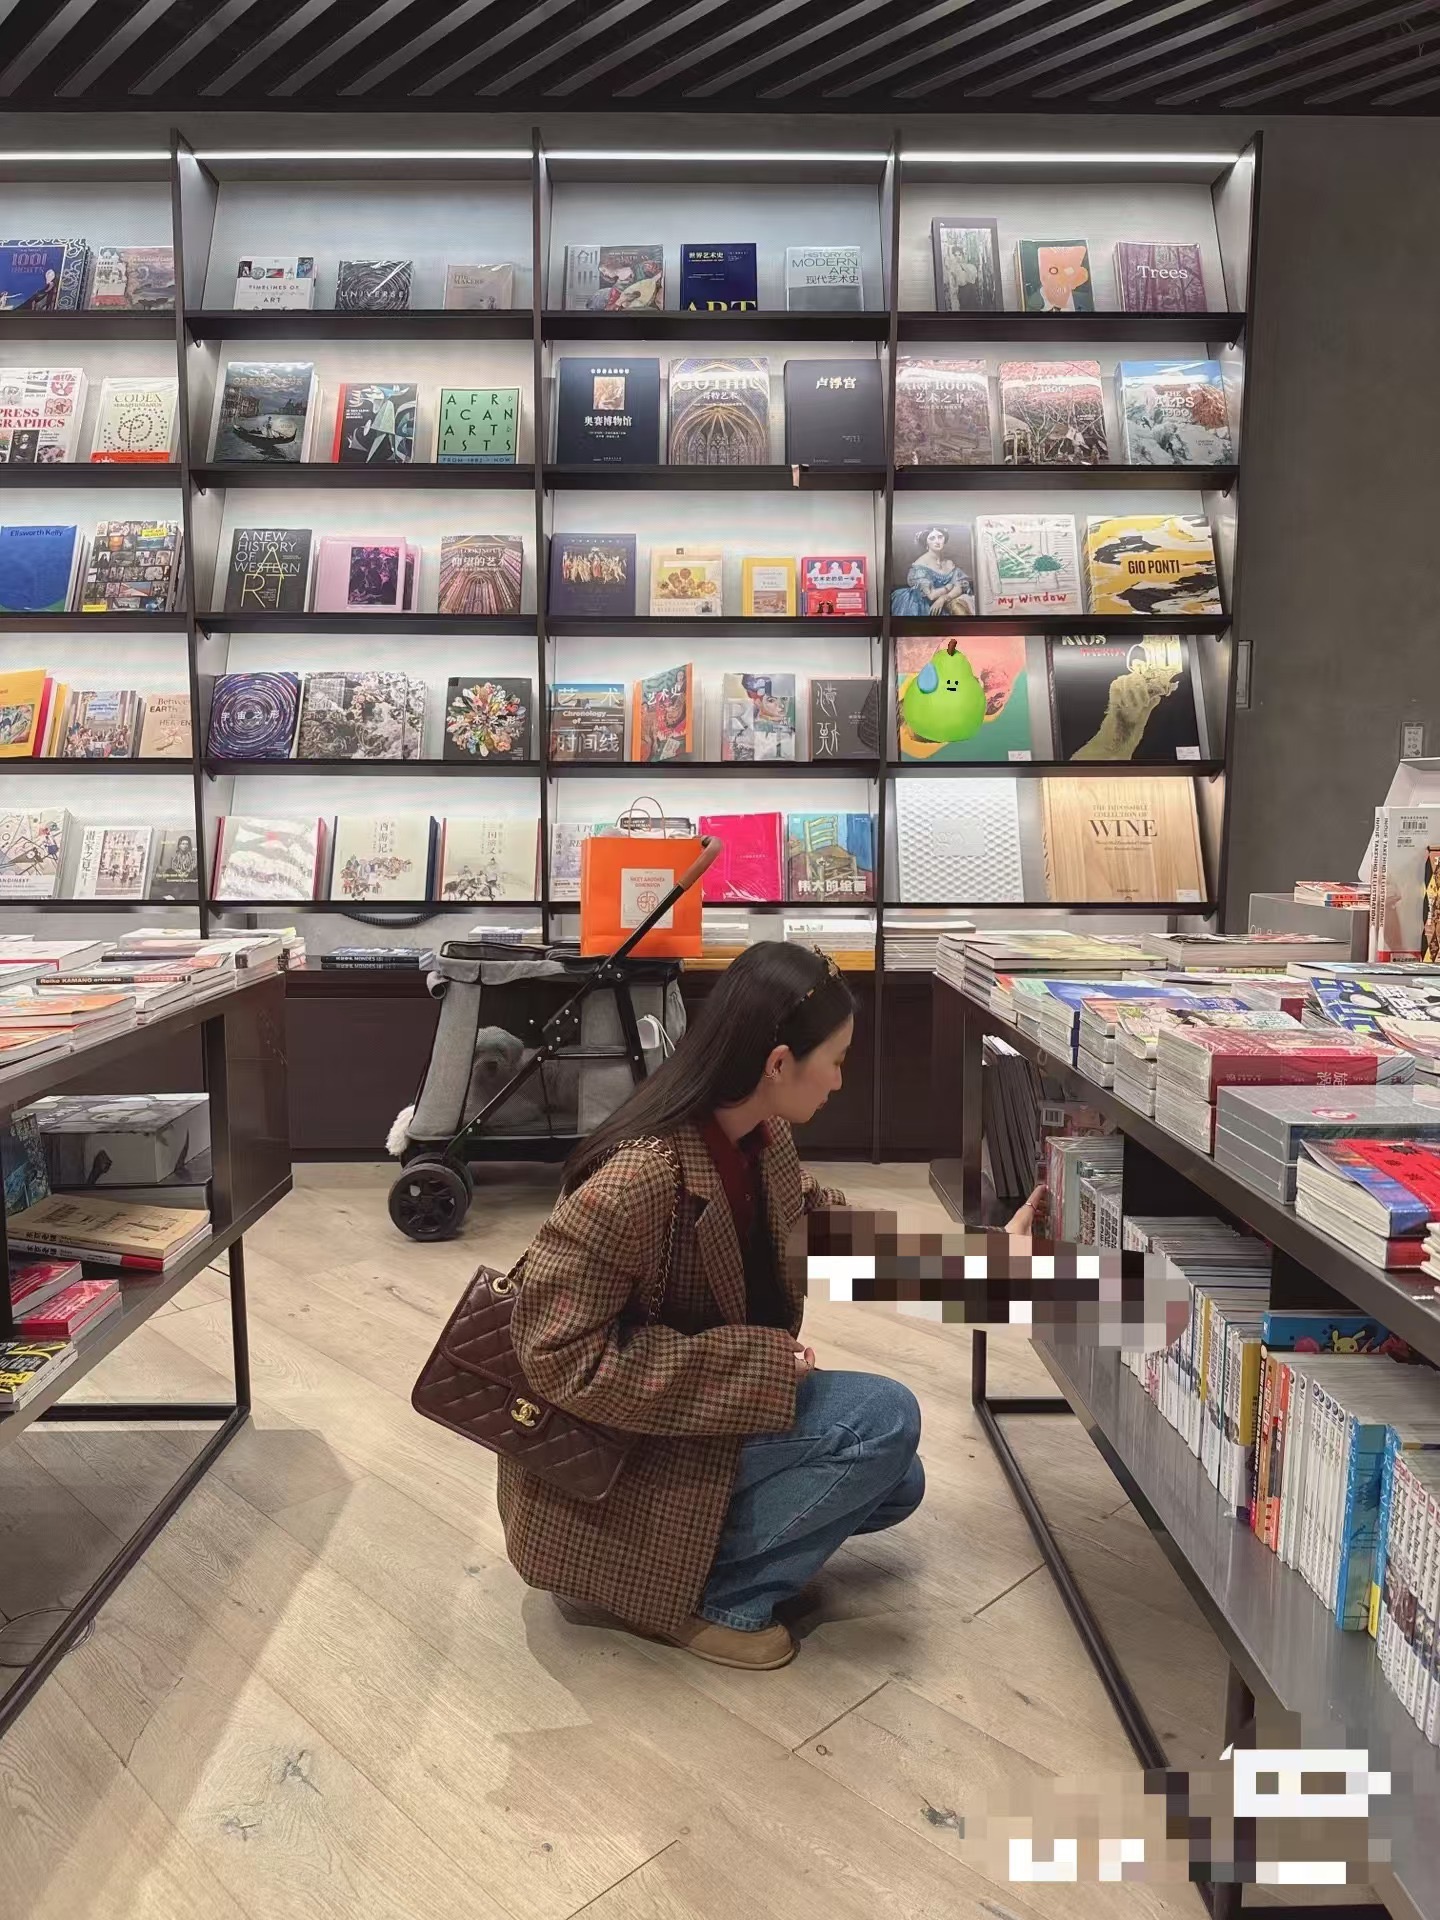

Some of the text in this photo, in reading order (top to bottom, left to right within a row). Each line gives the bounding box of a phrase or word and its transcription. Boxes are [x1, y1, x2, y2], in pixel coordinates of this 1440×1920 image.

[792, 258, 858, 267] MODERN
[1137, 265, 1188, 280] Trees
[805, 275, 859, 284] 现代艺术史
[341, 290, 404, 298] UNIVERSE
[815, 376, 857, 390] 卢浮宫
[935, 381, 978, 391] BOOK
[114, 393, 163, 403] CODEX
[915, 393, 965, 403] 艺术之书
[1153, 396, 1195, 408] ALPS
[584, 415, 633, 427] 奥赛博物馆
[10, 529, 64, 537] Ellsworth Kelly
[240, 531, 287, 542] A NEW
[237, 541, 297, 552] HISTORY
[235, 551, 256, 562] OF
[234, 562, 300, 573] WESTERN
[1128, 559, 1180, 574] GIO PONTI
[998, 593, 1067, 606] My Window
[646, 682, 683, 706] 艺术史
[221, 711, 280, 721] 宇宙之形
[557, 732, 620, 753] 时间线
[1088, 819, 1158, 837] WINE
[797, 879, 867, 892] 伟大的绘画
